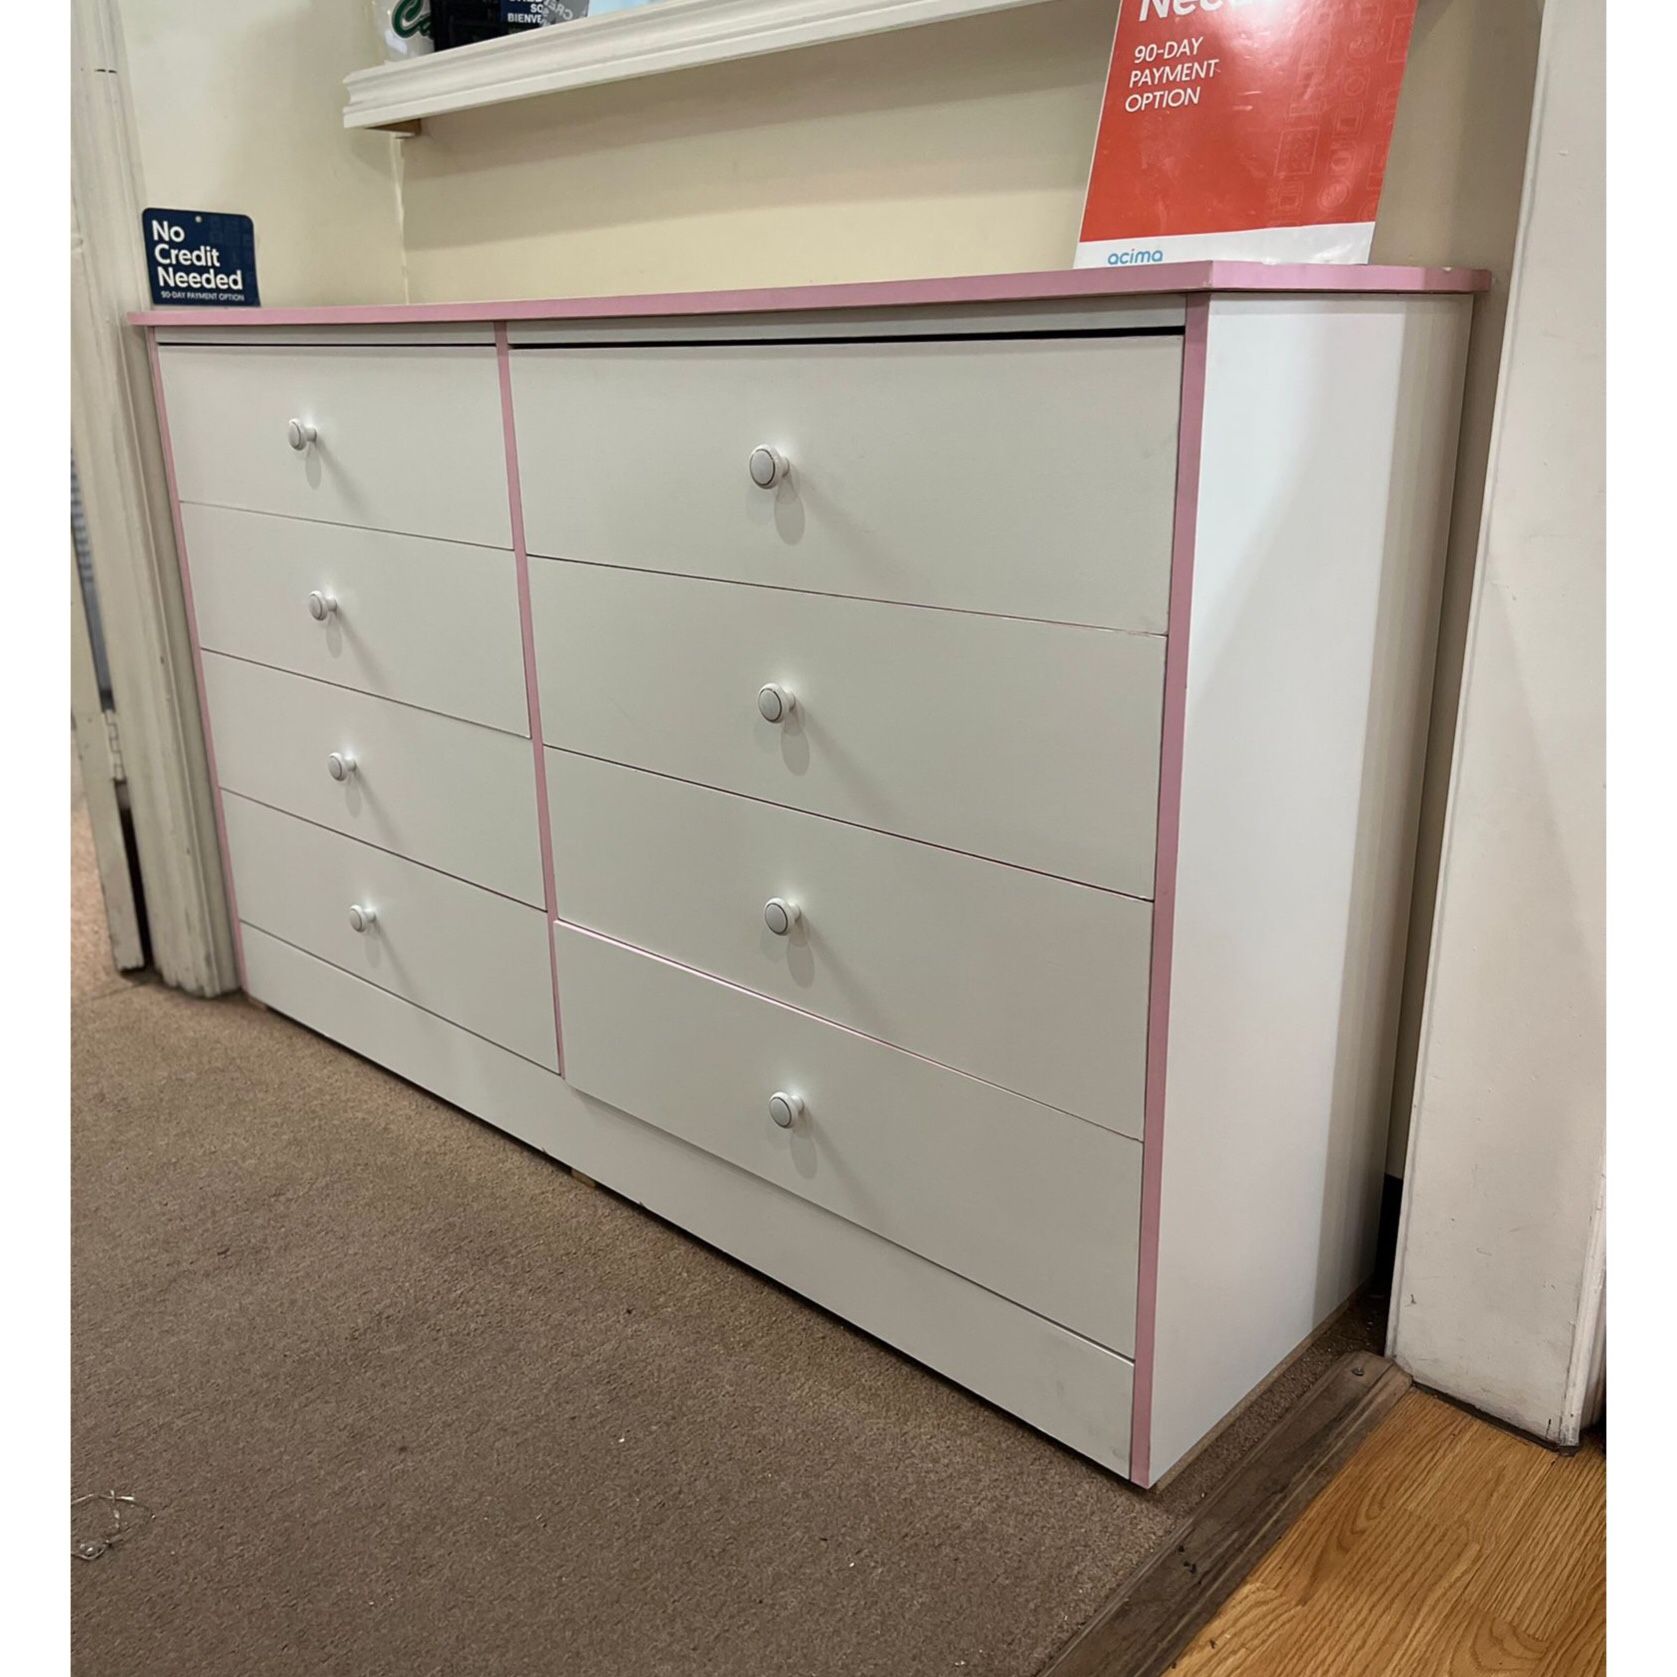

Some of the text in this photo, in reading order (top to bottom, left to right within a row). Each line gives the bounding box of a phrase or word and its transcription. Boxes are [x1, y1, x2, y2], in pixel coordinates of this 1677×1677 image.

[507, 12, 543, 24] BIENVE
[1133, 36, 1204, 64] 90-DAY
[1129, 59, 1220, 88] PAYMENT
[1125, 86, 1201, 113] OPTION
[152, 219, 185, 243] No
[154, 243, 221, 267] Credit
[1107, 248, 1164, 266] acima
[157, 266, 243, 290] Needed
[187, 291, 218, 300] PAYMENT
[218, 292, 245, 301] OPTION
